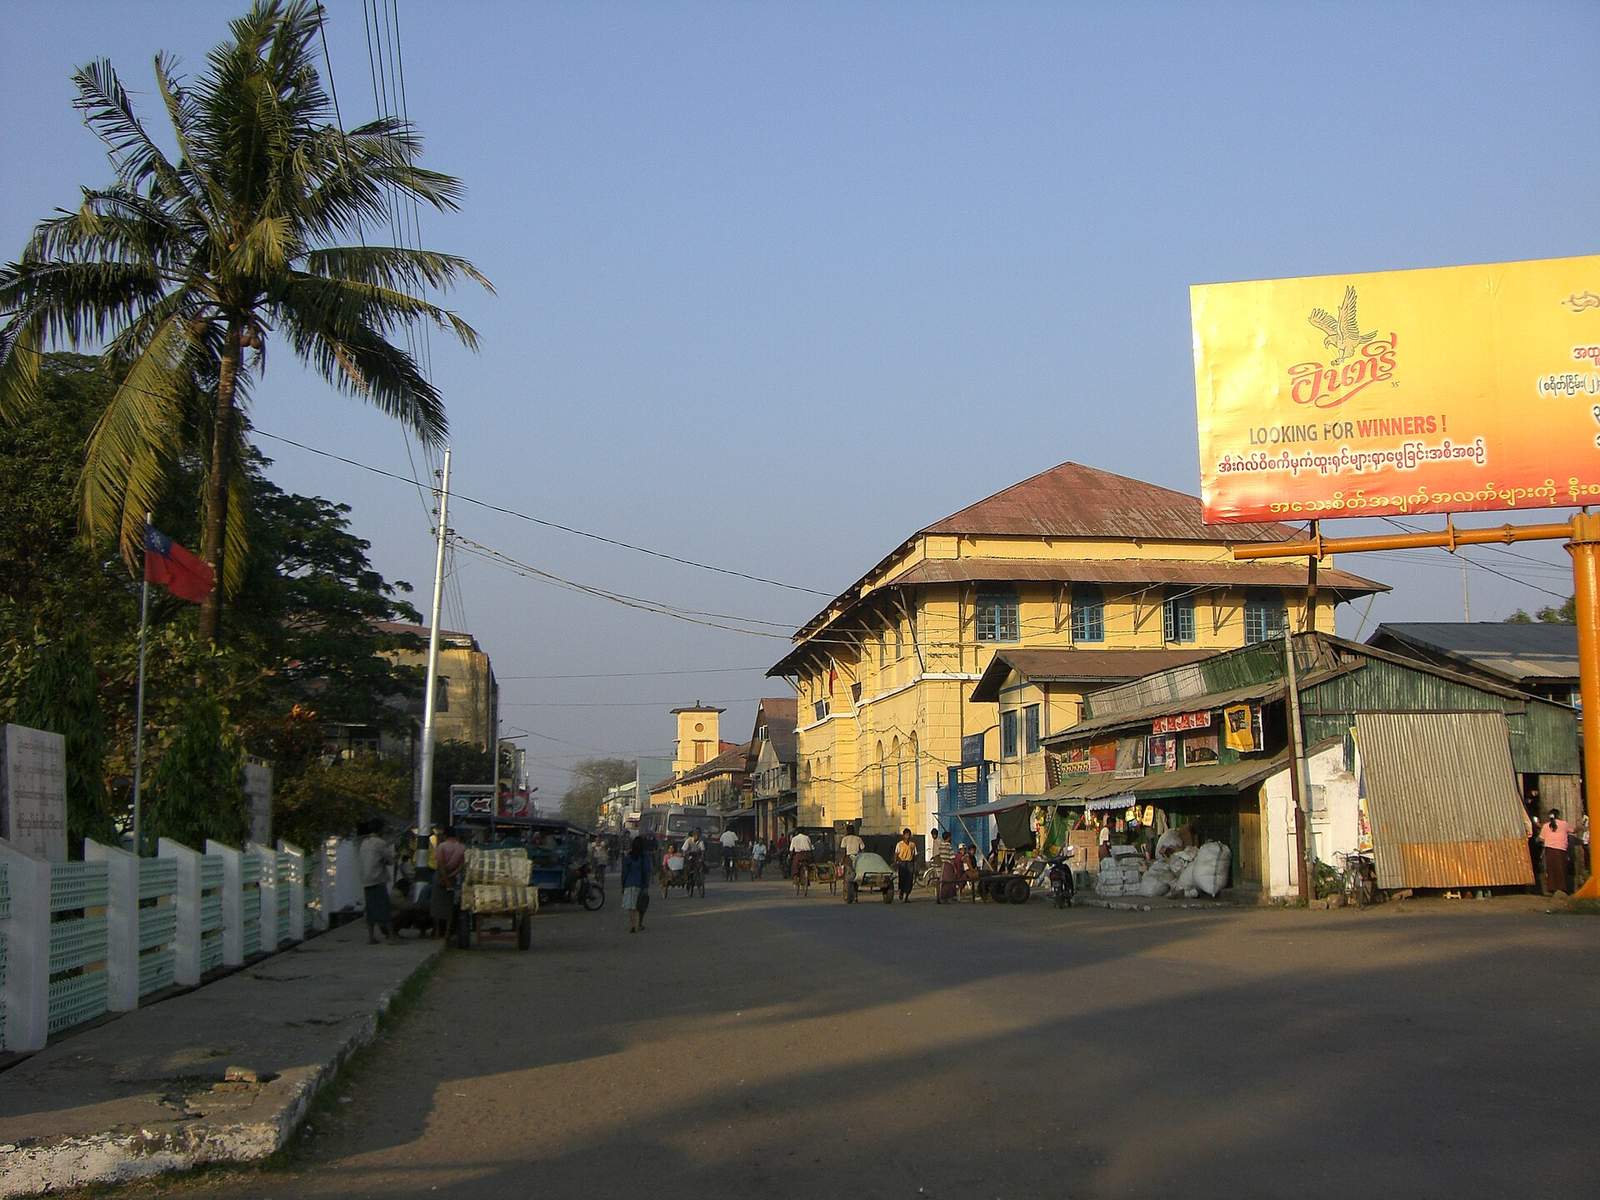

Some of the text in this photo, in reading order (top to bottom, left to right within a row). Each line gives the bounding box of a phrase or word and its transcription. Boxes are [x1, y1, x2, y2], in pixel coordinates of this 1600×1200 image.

[1249, 424, 1318, 445] LOOKING
[1324, 422, 1354, 440] FOR
[1357, 415, 1437, 438] WINNERS
